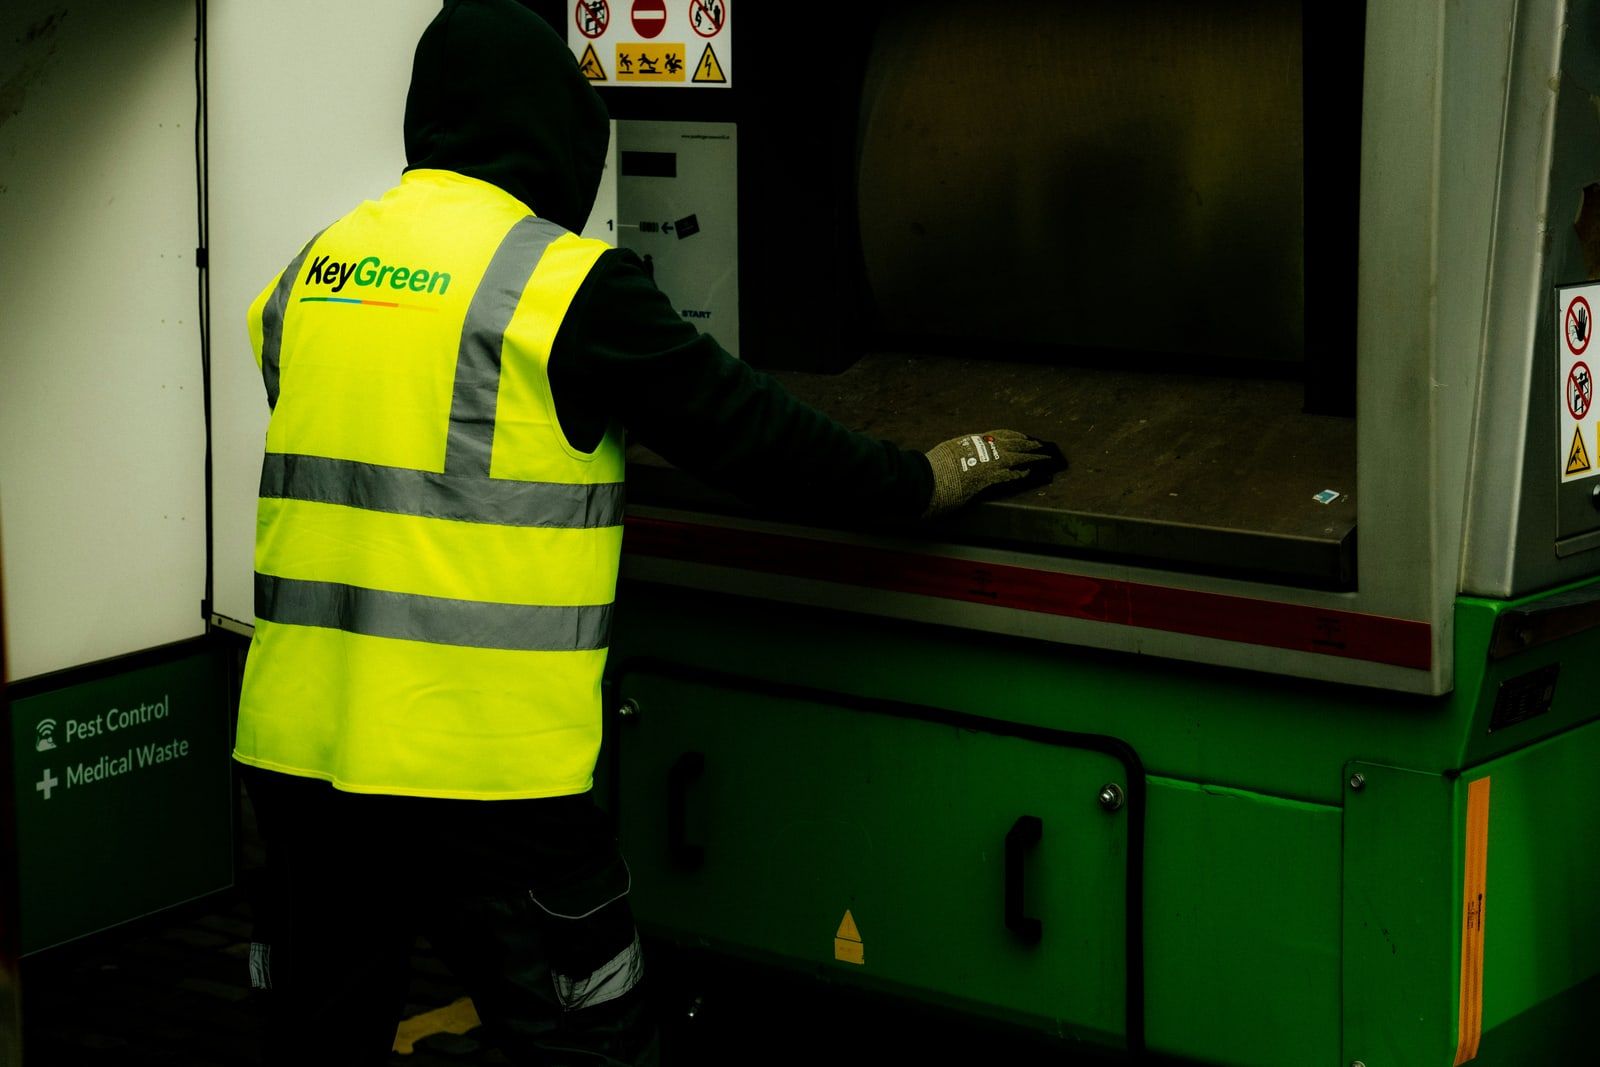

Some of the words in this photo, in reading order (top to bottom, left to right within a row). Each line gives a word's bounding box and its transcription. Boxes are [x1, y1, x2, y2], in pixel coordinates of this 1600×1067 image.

[606, 219, 613, 231] 1
[305, 255, 451, 295] KeyGreen
[682, 310, 711, 319] START
[65, 714, 103, 743] Pest
[106, 694, 169, 732] Control
[66, 749, 133, 789] Medical
[136, 737, 190, 768] Waste
